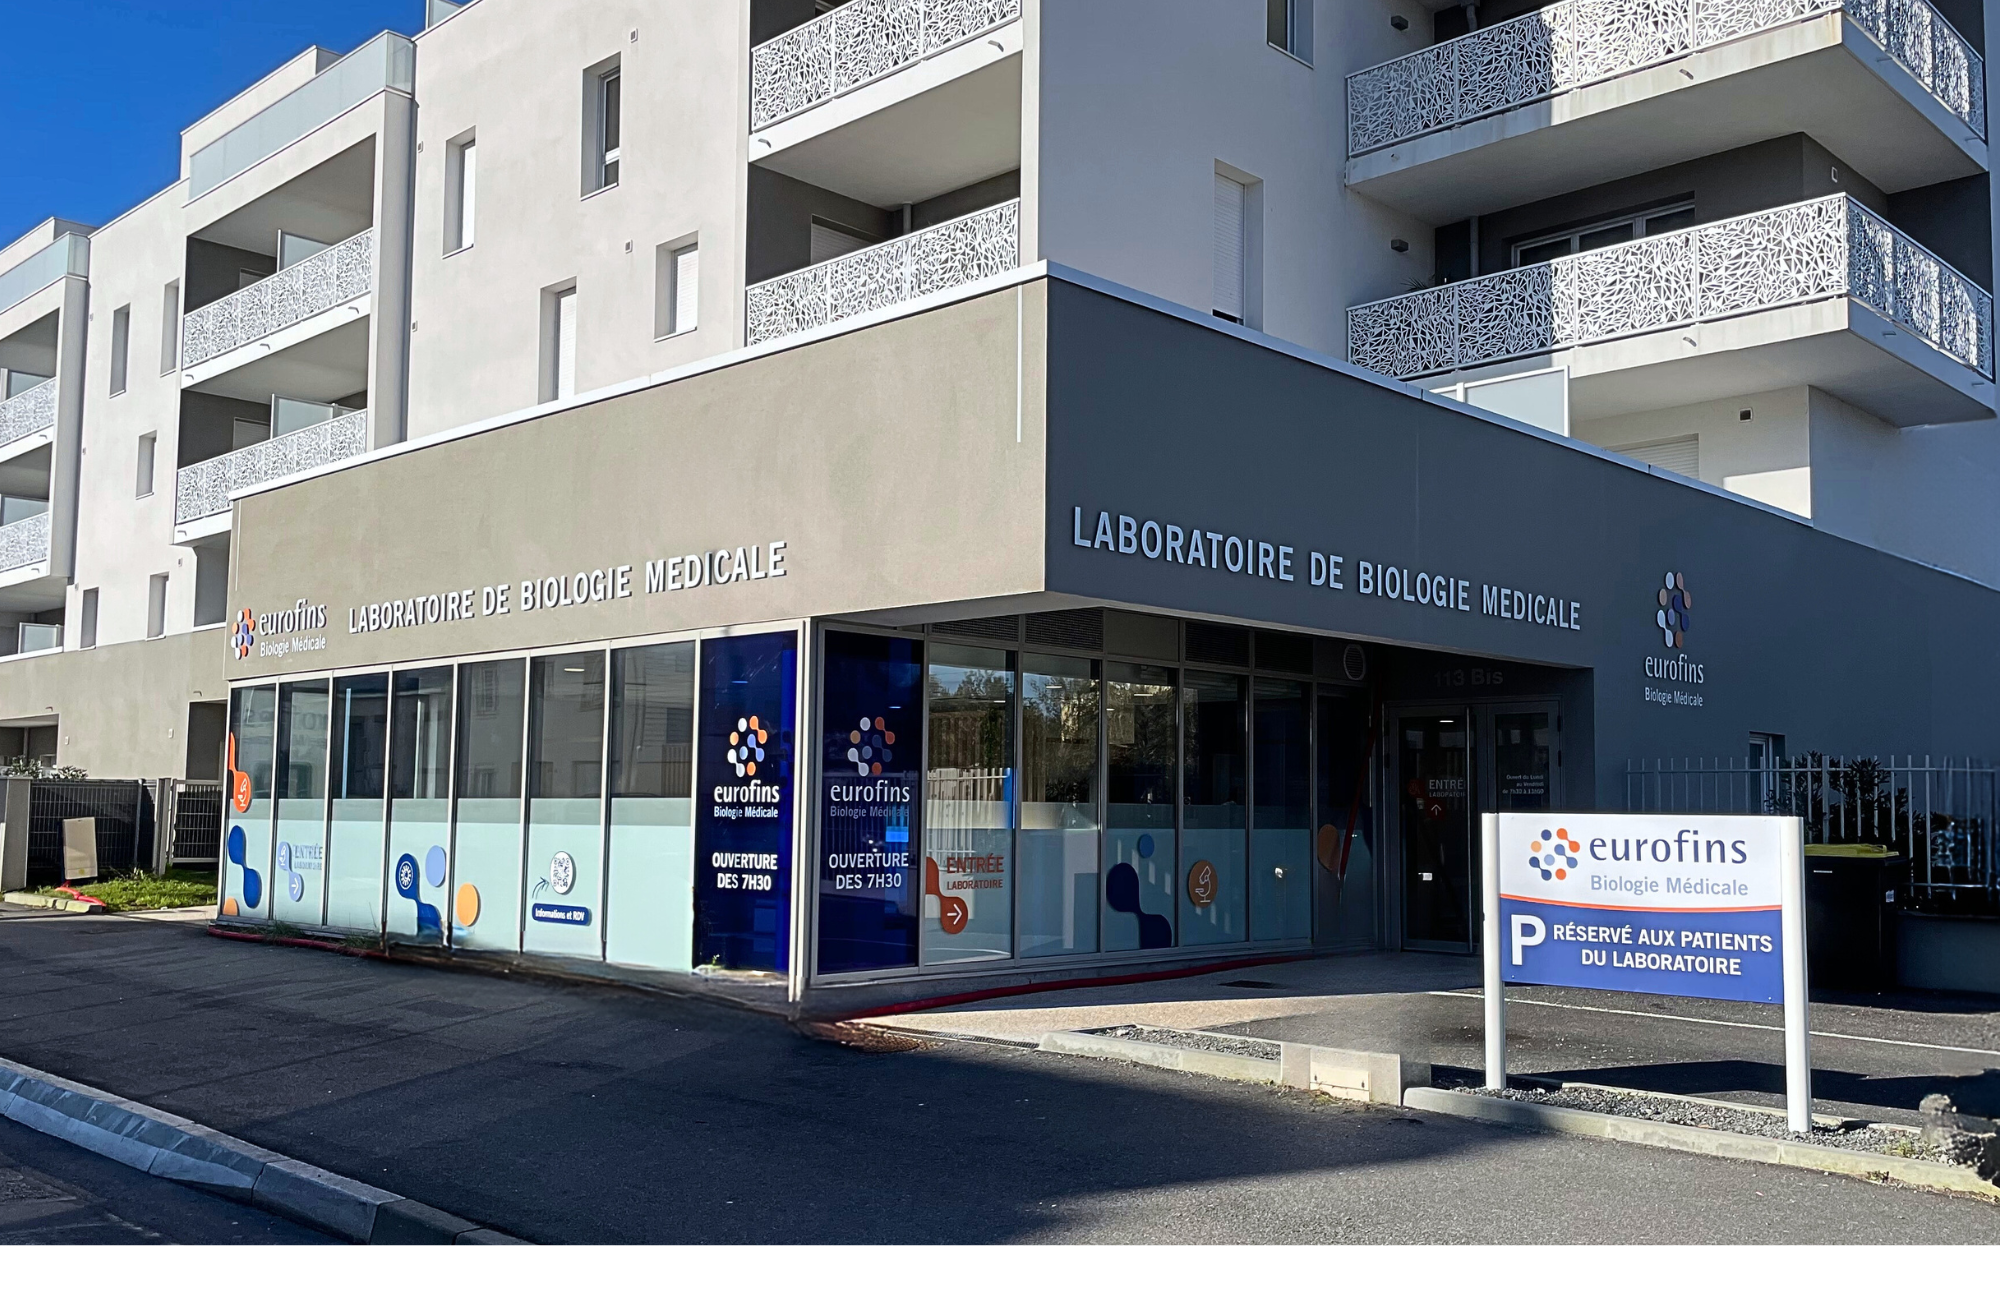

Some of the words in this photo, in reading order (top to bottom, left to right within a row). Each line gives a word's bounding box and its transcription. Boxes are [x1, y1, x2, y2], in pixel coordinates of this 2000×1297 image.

[1074, 506, 1294, 581] LABORATOIRE
[1310, 552, 1344, 590] DE
[1358, 560, 1470, 612] BIOLOGIE
[1482, 584, 1581, 631] MEDICALE
[349, 589, 475, 634] LABORATOIRE
[482, 584, 511, 616] DE
[520, 565, 633, 611] BIOLOGIE
[645, 540, 788, 594] MEDICALE
[258, 598, 328, 636] eurofins
[260, 640, 290, 658] Biologie
[291, 633, 326, 653] Médicale
[1434, 668, 1466, 687] 113
[1471, 668, 1504, 686] Bis
[1645, 653, 1704, 684] eurofins
[1644, 686, 1672, 706] Biologie
[1673, 690, 1703, 707] Médicale
[714, 780, 780, 803] eurofins
[830, 780, 910, 802] eurofins
[1429, 777, 1466, 790] ENTRÉ
[714, 806, 743, 820] Biologie
[744, 805, 779, 818] Médicale
[830, 805, 867, 818] Biologie
[1589, 829, 1748, 865] eurofins
[712, 852, 778, 870] OUVERTURE
[828, 852, 909, 869] OUVERTURE
[946, 853, 1005, 874] ENTRÉE
[717, 873, 739, 889] DES
[741, 874, 772, 891] 7H30
[835, 874, 863, 890] DES
[866, 873, 902, 889] 7H30
[946, 879, 1004, 891] LABORATOIRE
[1590, 875, 1660, 896] Biologie
[1666, 877, 1749, 896] Médicale
[535, 908, 566, 920] Informations
[566, 911, 573, 920] et
[573, 911, 586, 921] RDV
[1511, 914, 1547, 966] P
[1553, 922, 1633, 945] RÉSERVÉ
[1637, 929, 1676, 947] AUX
[1681, 931, 1773, 953] PATIENTS
[1581, 949, 1607, 966] DU
[1612, 951, 1742, 976] LABORATOIRE
